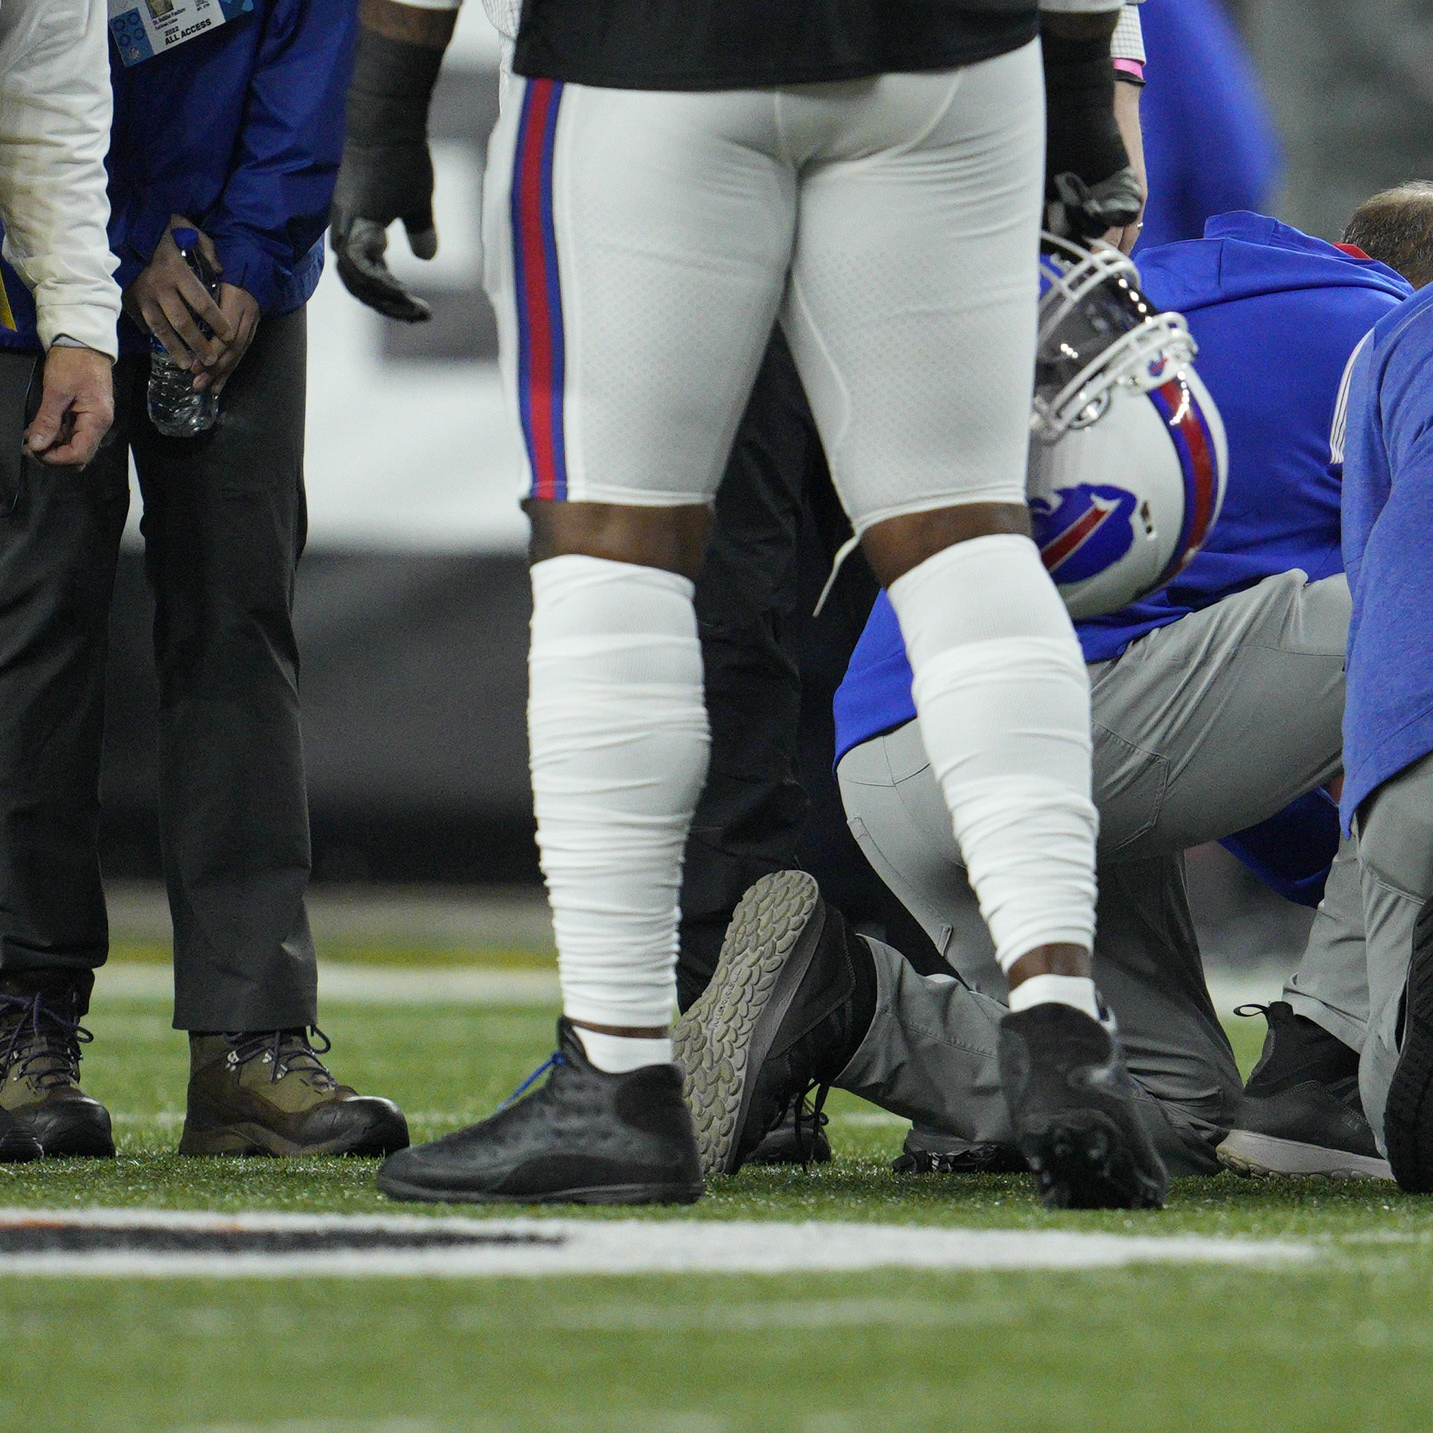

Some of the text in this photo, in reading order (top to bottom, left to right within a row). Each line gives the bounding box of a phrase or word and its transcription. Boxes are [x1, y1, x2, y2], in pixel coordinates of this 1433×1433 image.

[164, 26, 180, 36] 2022
[165, 35, 180, 45] ALL
[181, 19, 212, 39] ACCESS
